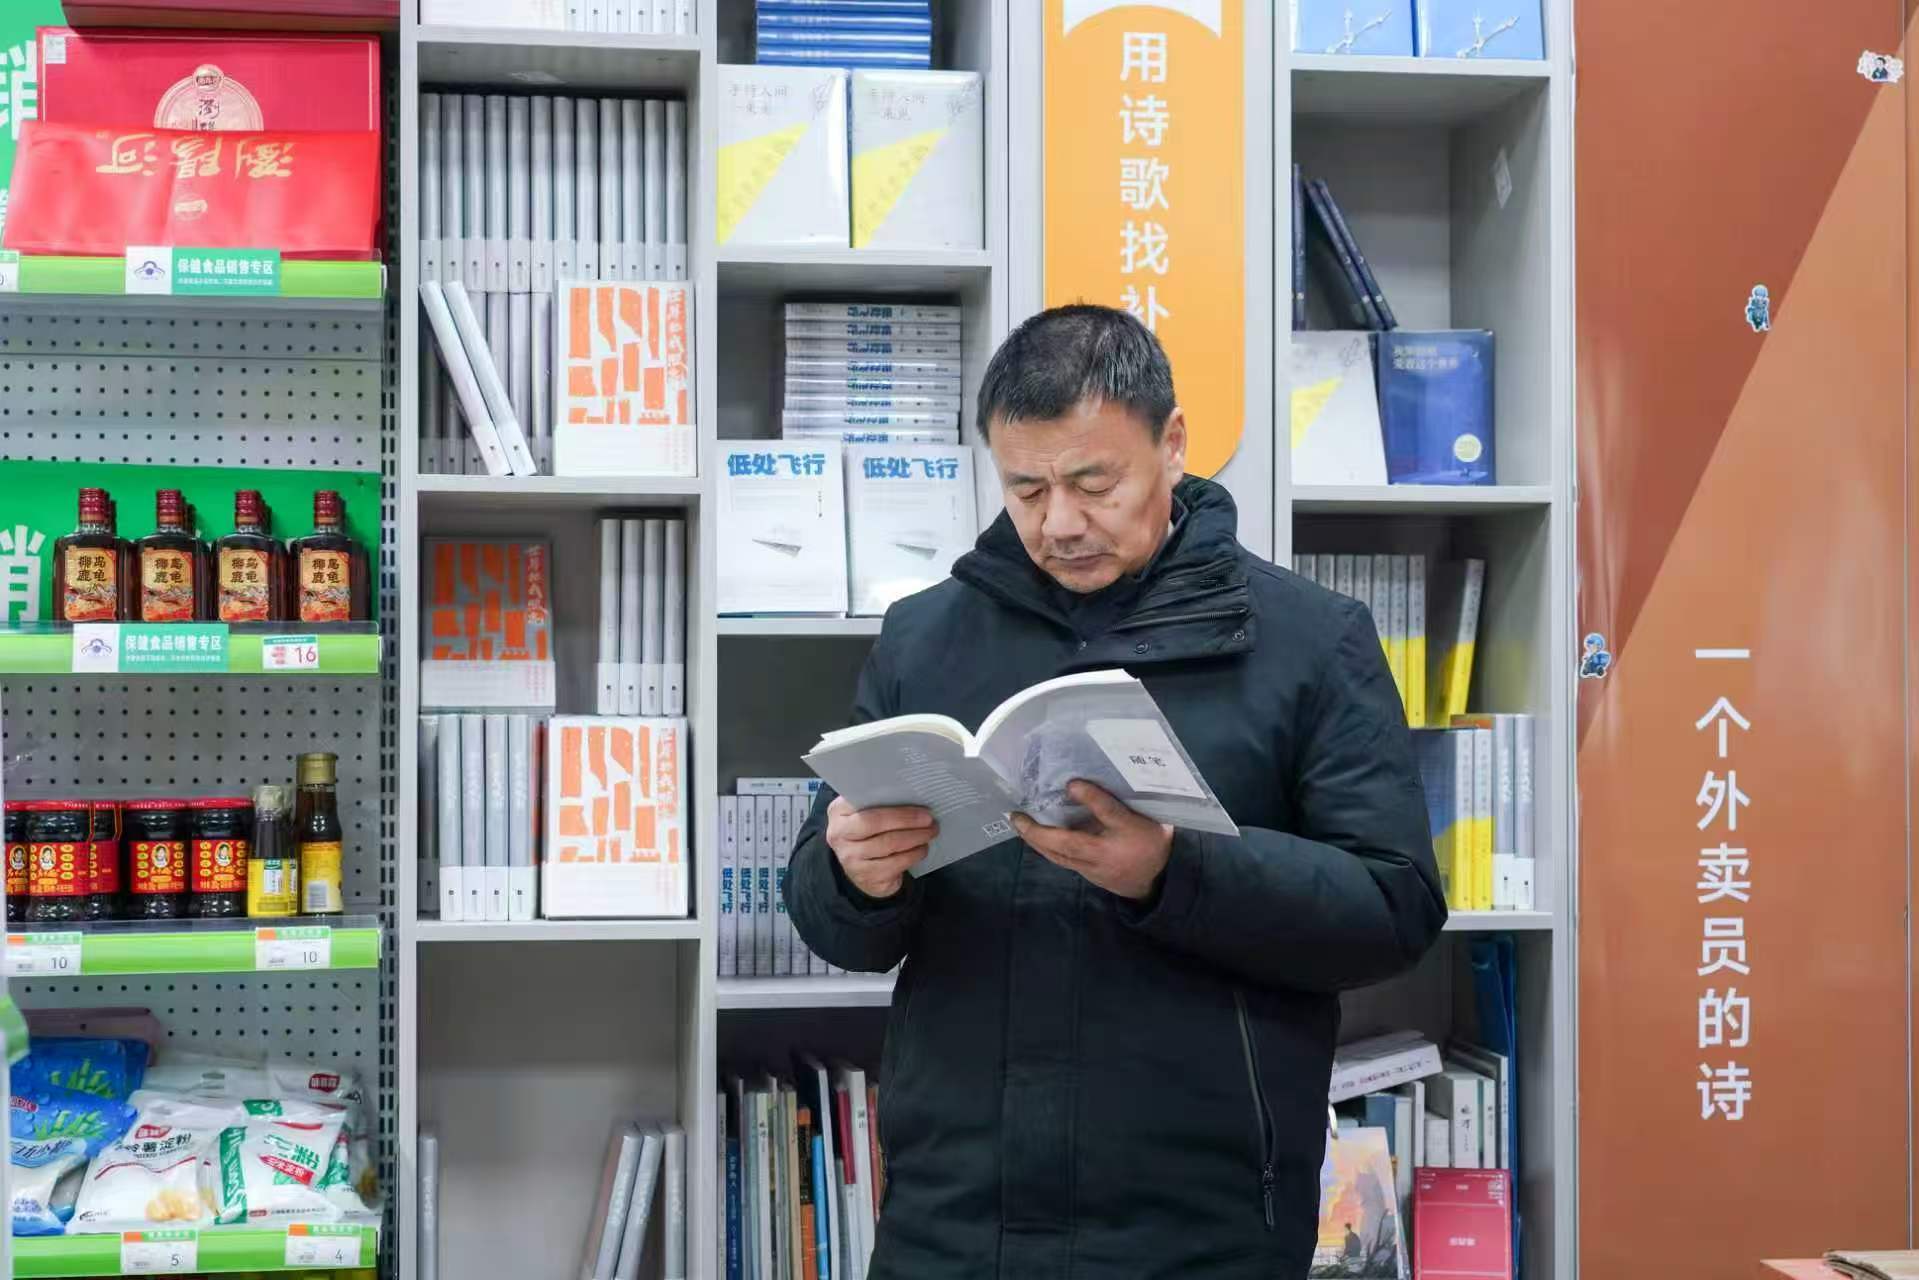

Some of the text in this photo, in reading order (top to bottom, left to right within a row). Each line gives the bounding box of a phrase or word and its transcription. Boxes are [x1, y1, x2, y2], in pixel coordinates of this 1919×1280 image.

[1119, 31, 1170, 333] 用诗歌找补
[178, 258, 273, 275] 保健食品销售专区
[727, 453, 826, 478] 低处飞行
[863, 456, 959, 480] 低处飞行
[125, 635, 222, 650] 保健食品销售专区
[294, 646, 317, 664] 16
[1128, 754, 1168, 768] 随笔
[1694, 648, 1752, 1121] 一个外卖员的诗
[50, 956, 68, 969] 10
[303, 951, 318, 963] 10
[171, 1254, 180, 1267] 5
[335, 1250, 343, 1264] 4
